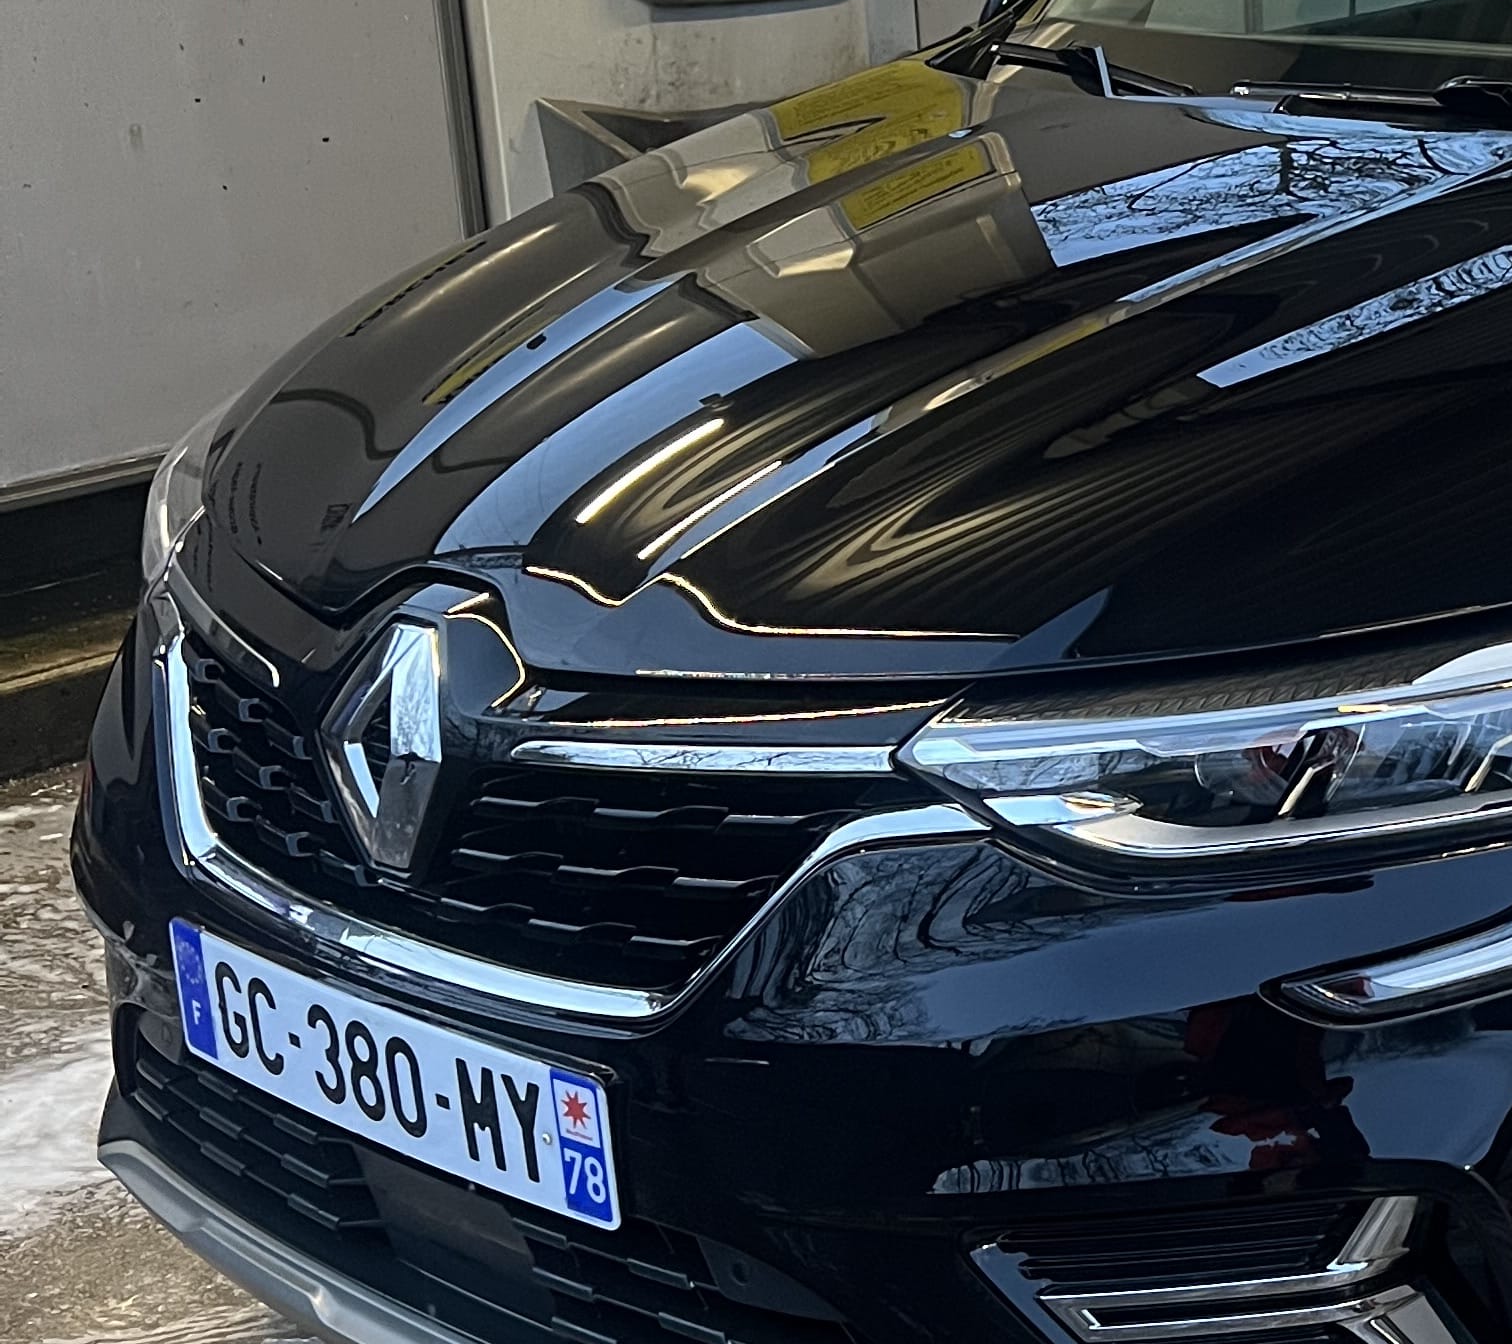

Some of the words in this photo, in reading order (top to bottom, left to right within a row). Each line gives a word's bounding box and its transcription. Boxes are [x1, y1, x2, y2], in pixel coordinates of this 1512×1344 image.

[193, 1000, 202, 1025] F
[215, 961, 541, 1183] GC-380-MY
[563, 1147, 607, 1204] 78
